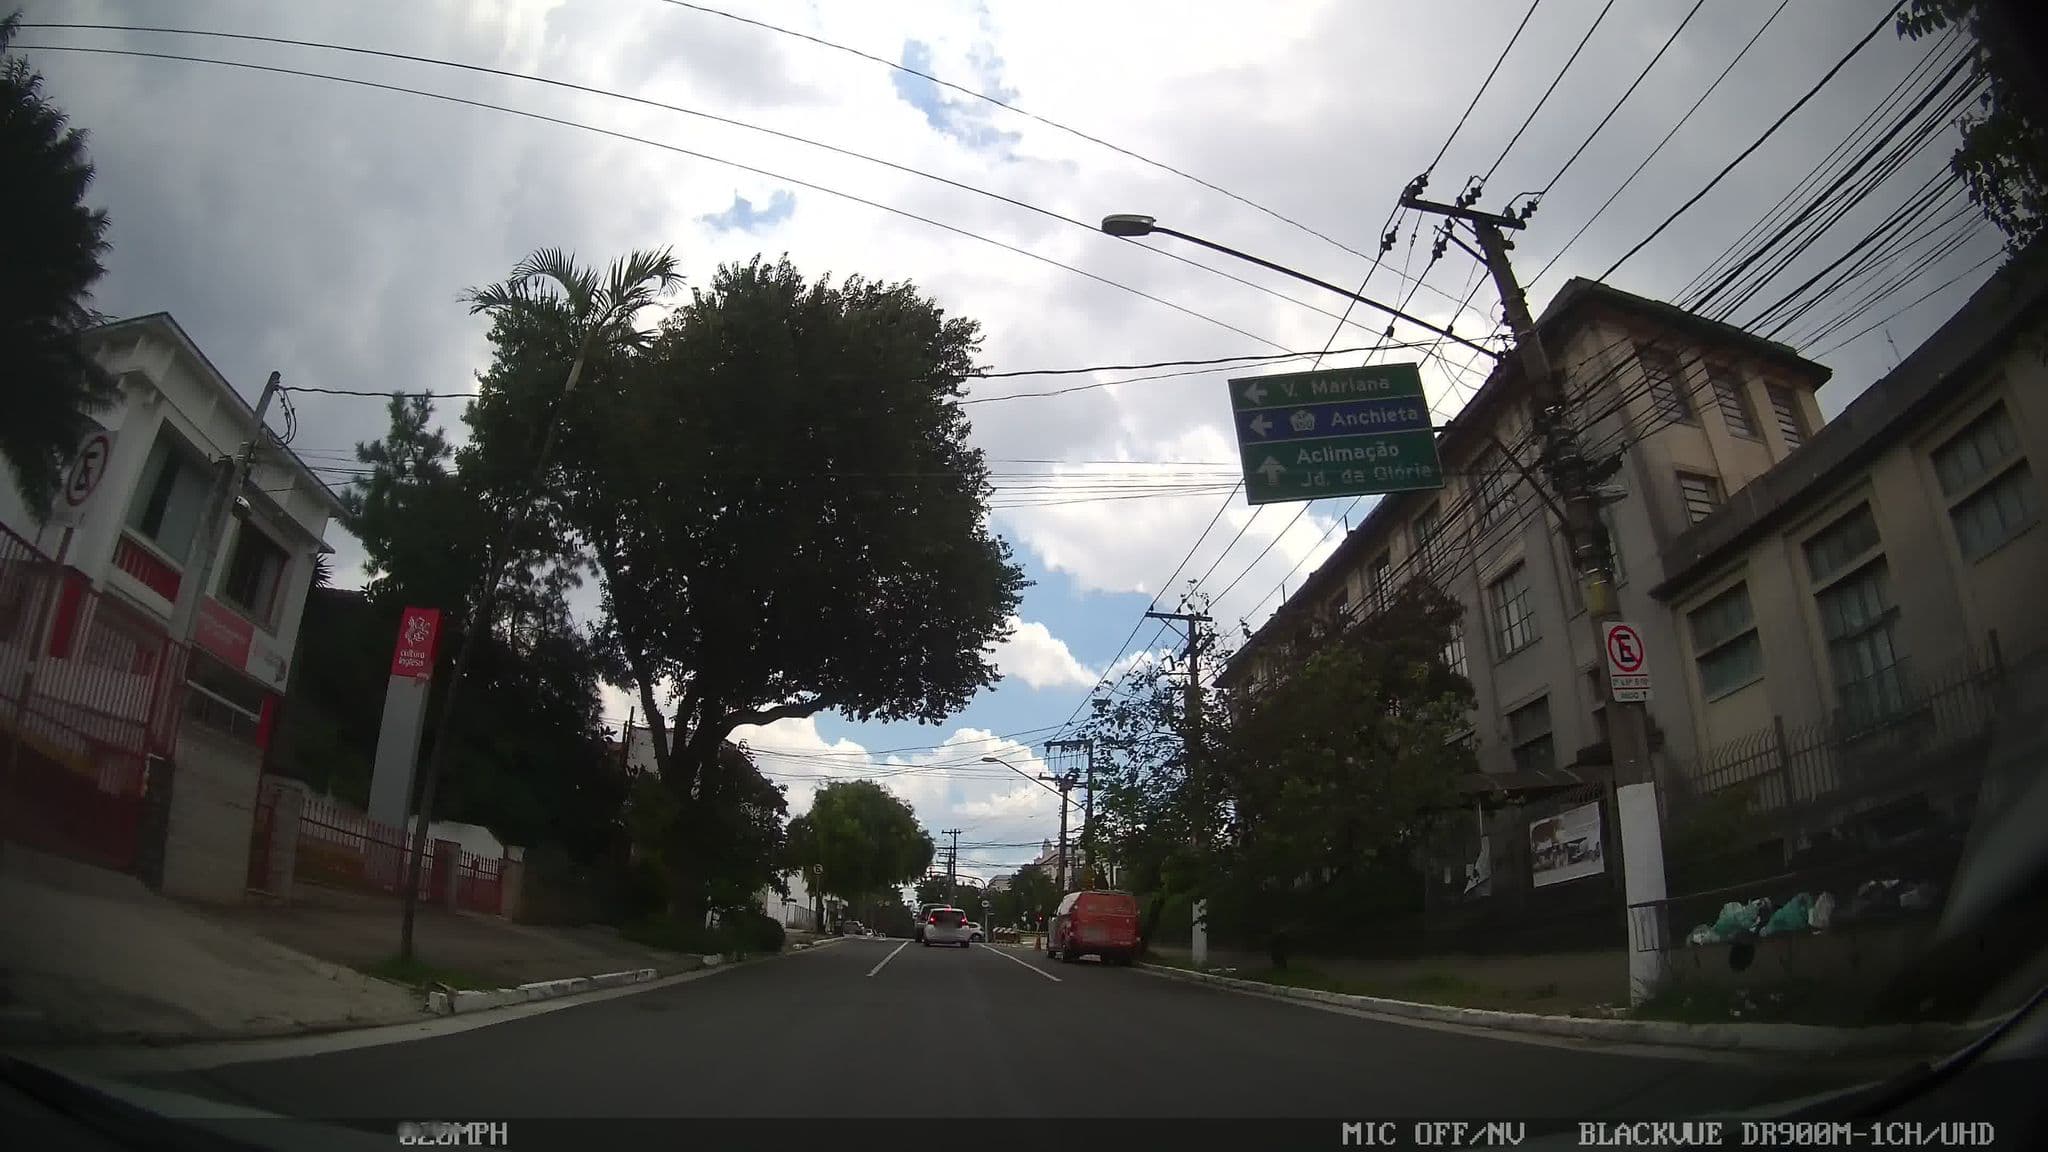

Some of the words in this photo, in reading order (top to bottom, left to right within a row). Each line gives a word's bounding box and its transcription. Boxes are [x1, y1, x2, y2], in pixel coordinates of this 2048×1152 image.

[1280, 382, 1298, 398] V.
[1311, 377, 1391, 396] Mariana
[1330, 407, 1419, 427] Anchieta
[1296, 440, 1400, 465] Aclimação
[1300, 471, 1330, 488] Jd.
[1341, 468, 1365, 484] da
[398, 656, 424, 669] inglesa
[400, 647, 425, 659] cultura
